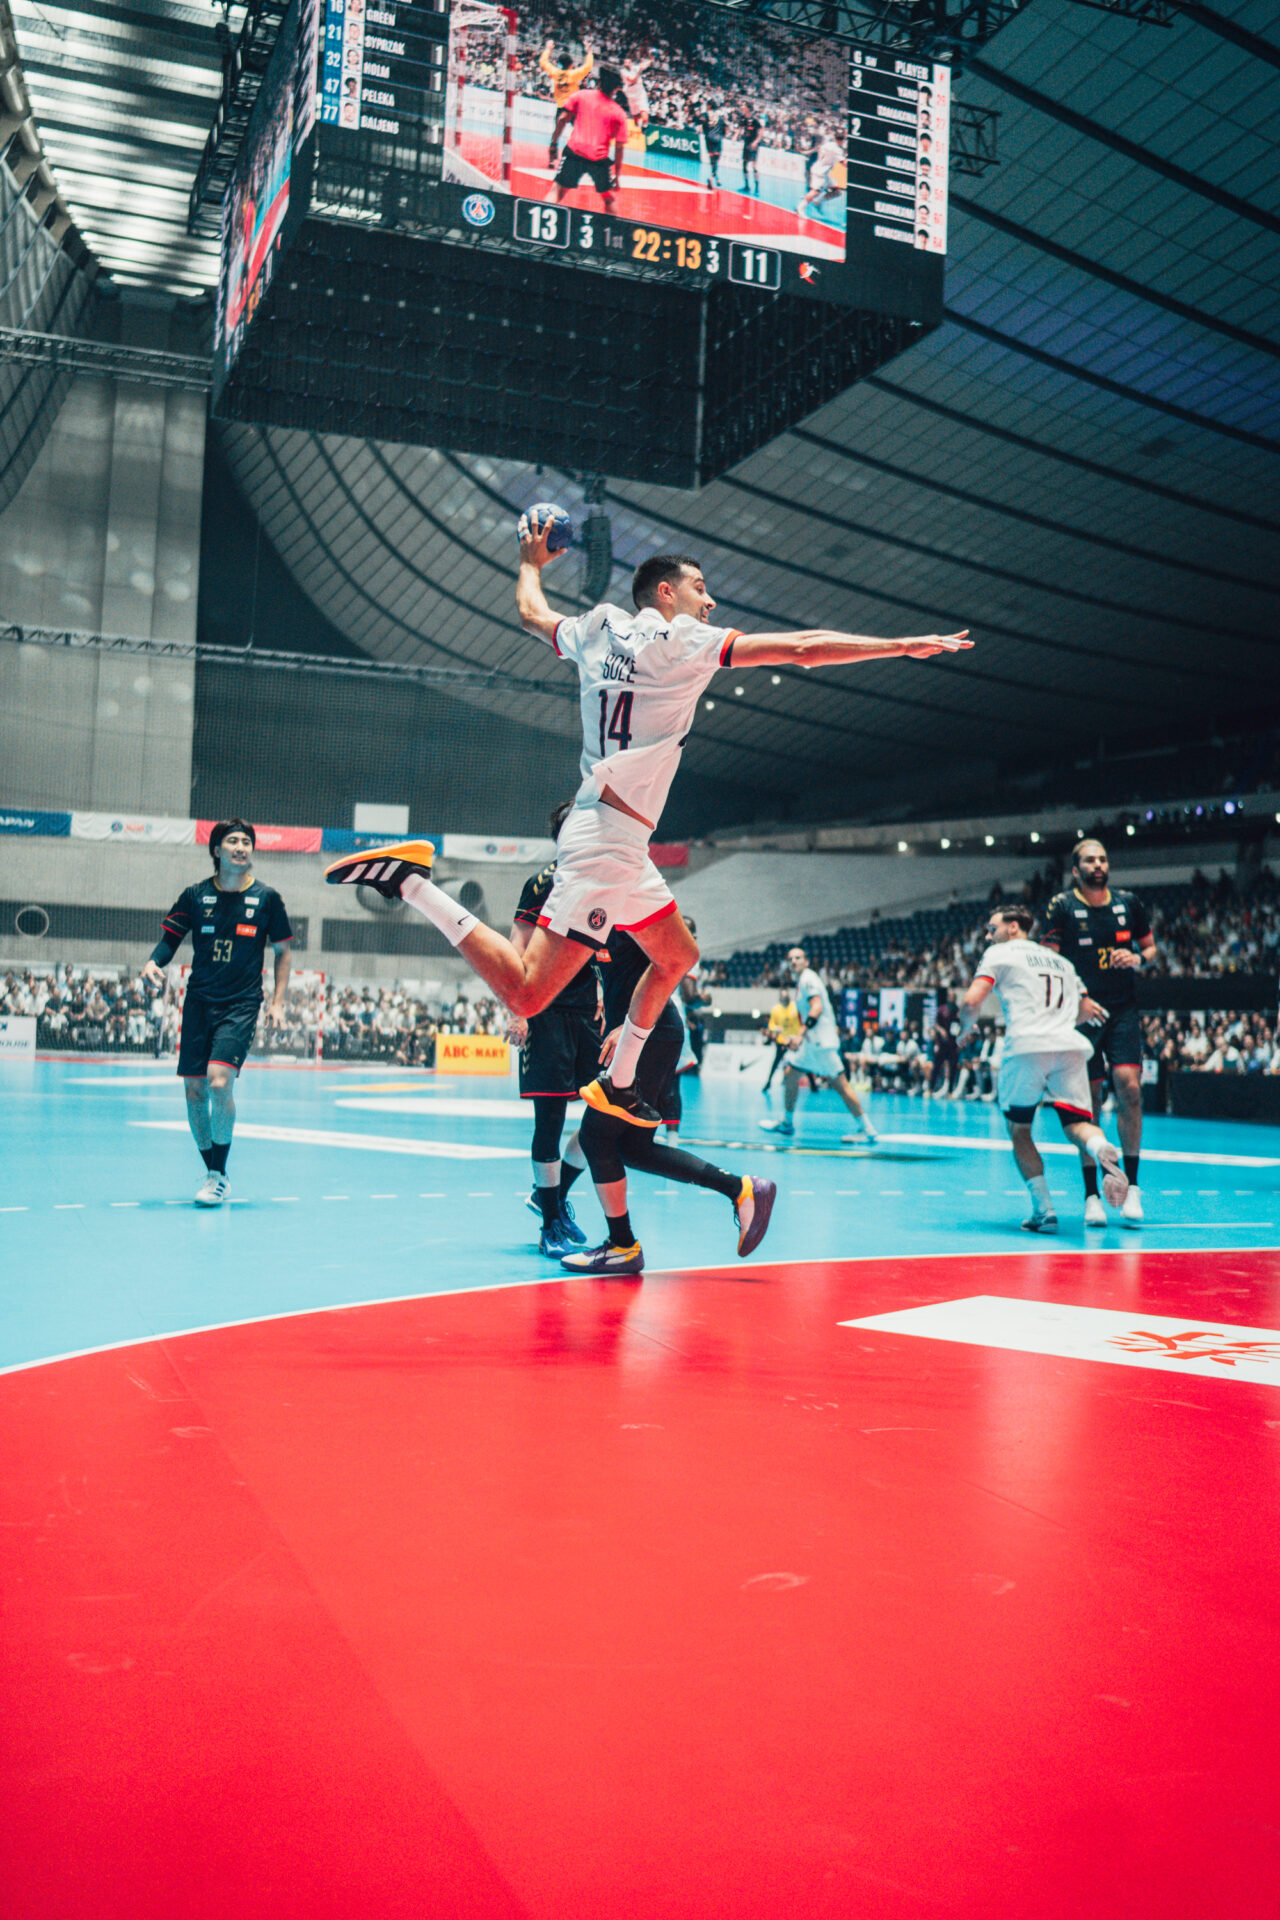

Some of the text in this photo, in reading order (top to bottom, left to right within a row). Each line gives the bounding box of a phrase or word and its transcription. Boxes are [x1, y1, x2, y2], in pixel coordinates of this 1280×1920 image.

[366, 8, 396, 26] GREEN
[328, 24, 342, 40] 21
[435, 45, 443, 65] 1
[326, 51, 341, 67] 32
[433, 71, 441, 91] 1
[852, 70, 862, 88] 3
[894, 60, 929, 81] PLAYER
[324, 78, 395, 107] 47 PELEKA
[323, 105, 338, 121] 77
[432, 124, 439, 144] 1
[851, 117, 861, 136] 2
[660, 135, 699, 153] SMBC
[581, 214, 593, 225] T
[528, 206, 558, 241] 13
[632, 228, 702, 270] 22:13
[742, 249, 768, 283] 11
[579, 225, 594, 249] 3
[708, 240, 719, 249] T
[706, 250, 720, 274] 3
[598, 688, 634, 758] 14
[213, 939, 233, 963] 53
